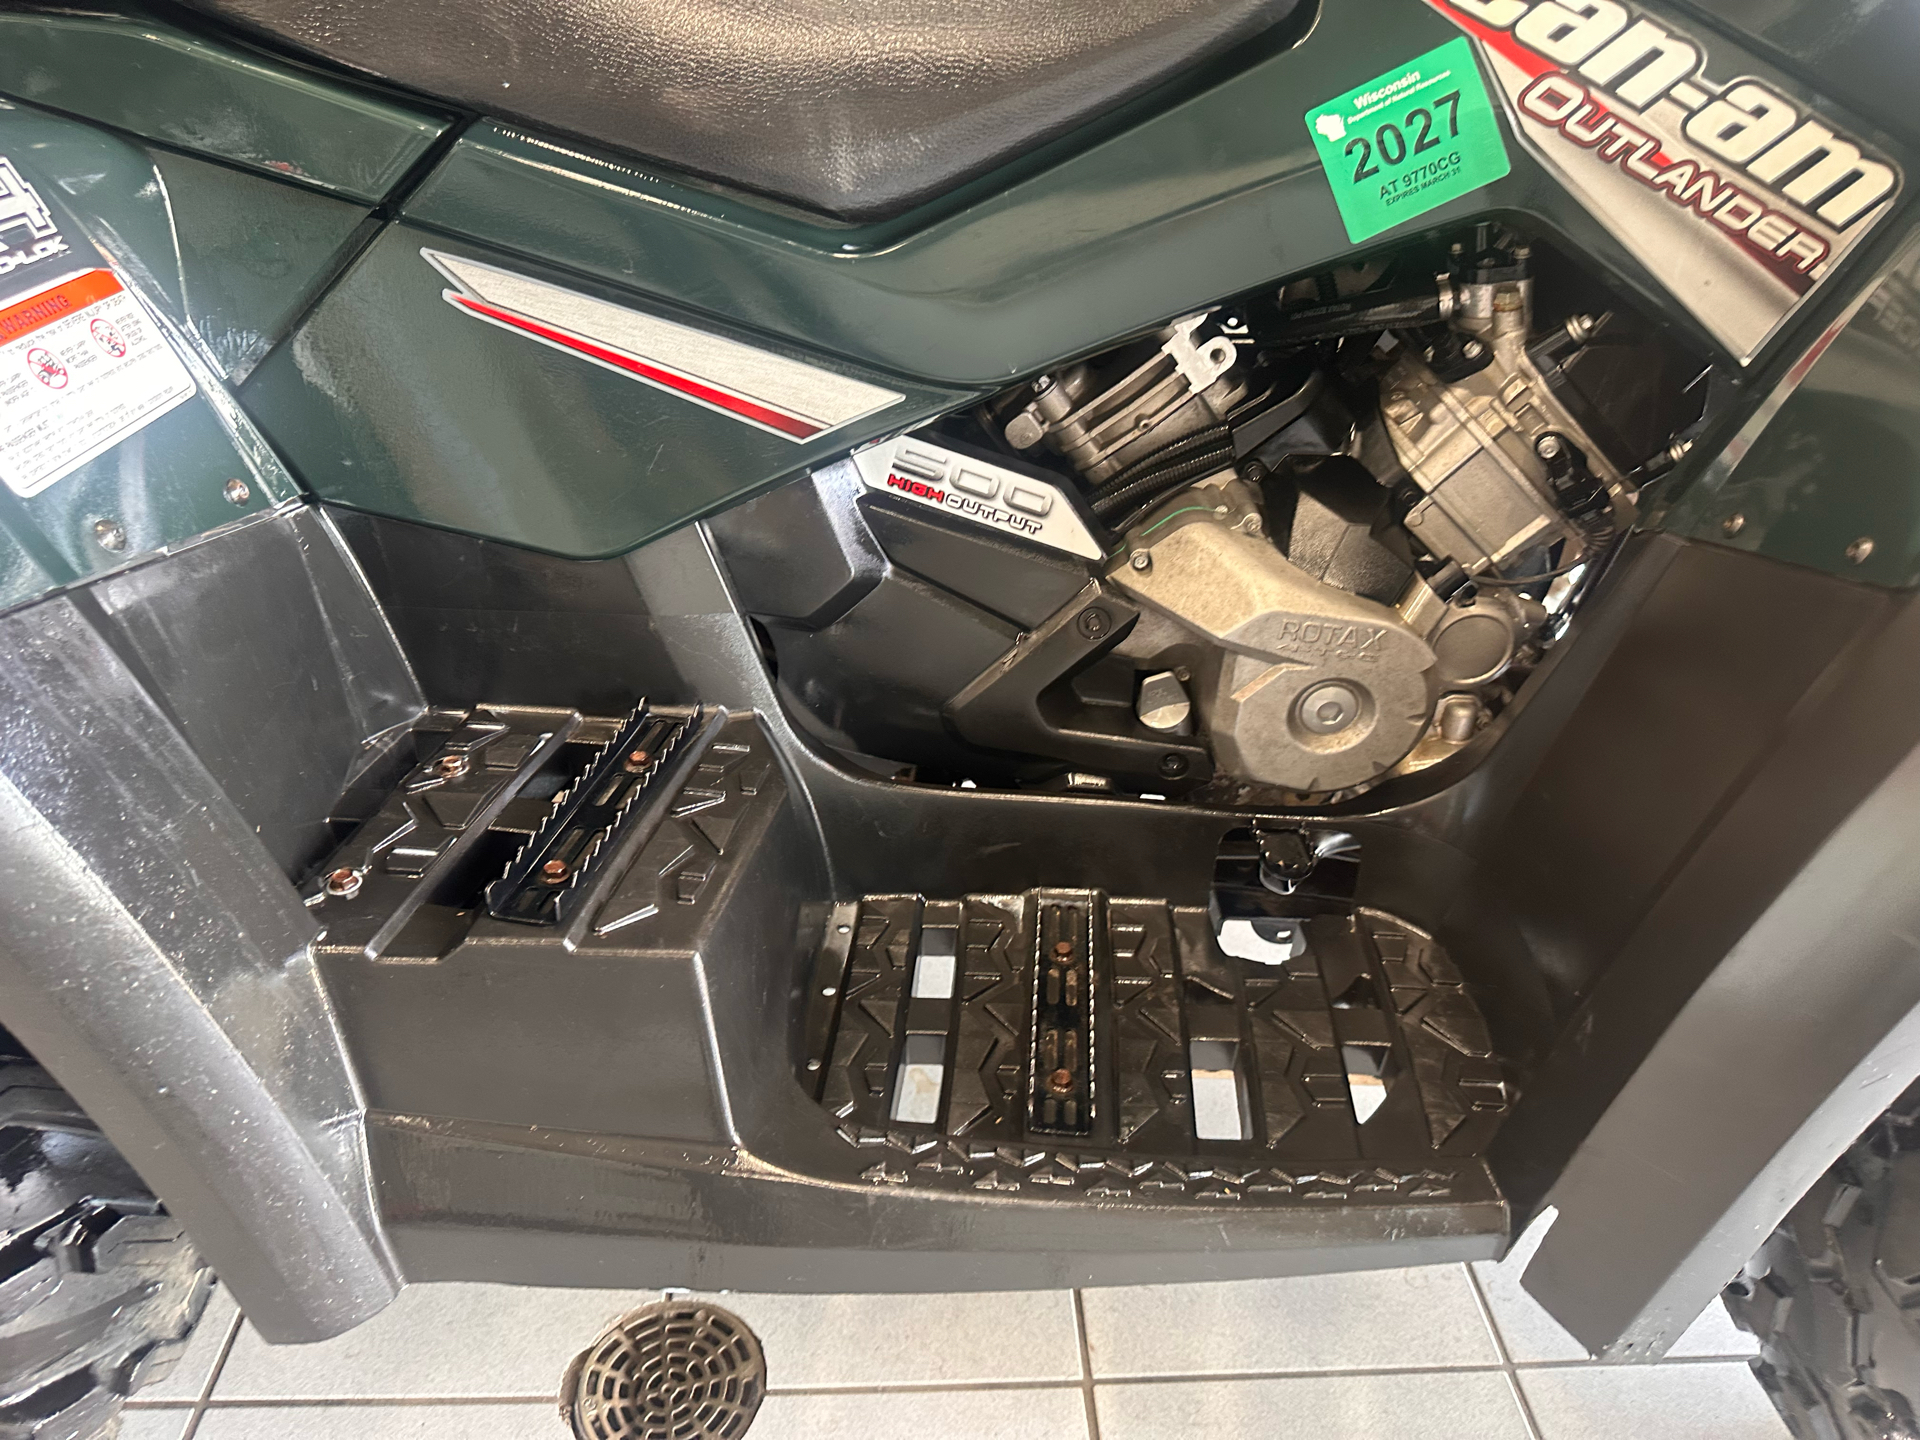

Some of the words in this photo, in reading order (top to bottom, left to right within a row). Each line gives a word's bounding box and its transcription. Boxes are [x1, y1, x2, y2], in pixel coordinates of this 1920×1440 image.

[1353, 70, 1421, 110] Wisconsin
[1344, 89, 1462, 184] 2027
[1379, 178, 1398, 200] AT
[1402, 151, 1461, 188] 9770CG
[1385, 184, 1420, 207] EXPIRES
[1420, 170, 1451, 191] MARCH
[1519, 72, 1829, 272] OUTLANDER
[2, 294, 71, 337] WARNING
[886, 473, 944, 504] HIGH
[945, 493, 1043, 536] OUTPUT
[892, 445, 1054, 518] 500
[1276, 618, 1388, 652] ROTAX
